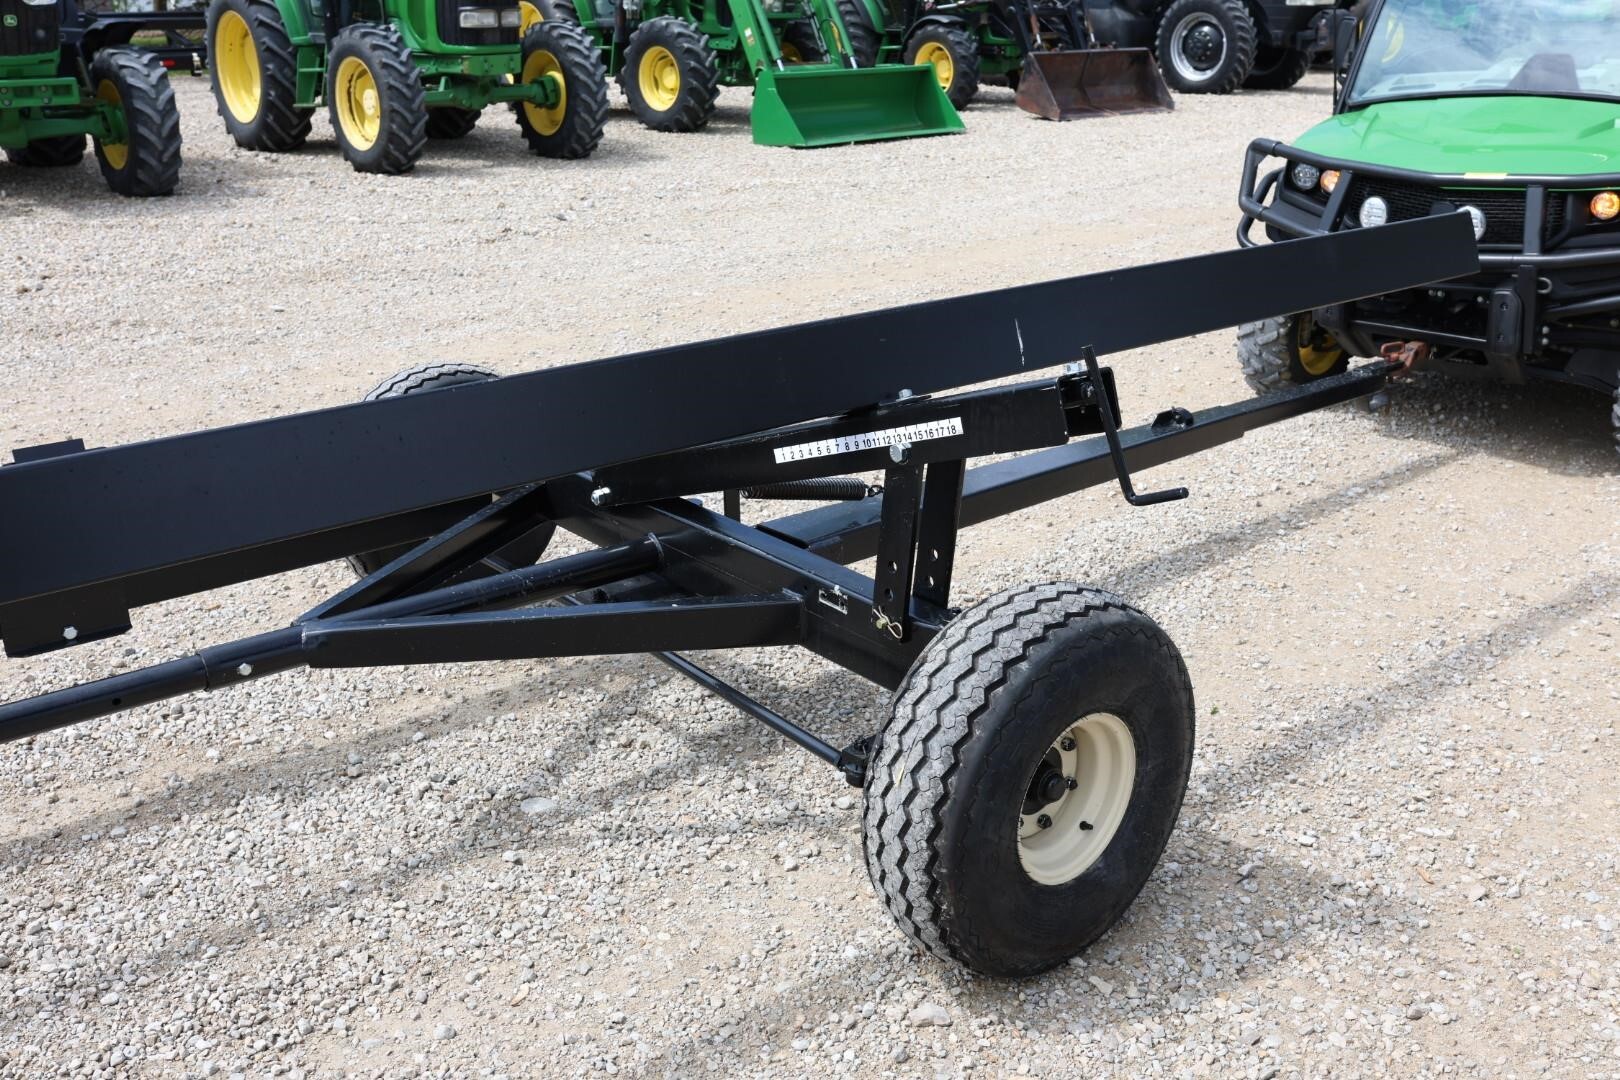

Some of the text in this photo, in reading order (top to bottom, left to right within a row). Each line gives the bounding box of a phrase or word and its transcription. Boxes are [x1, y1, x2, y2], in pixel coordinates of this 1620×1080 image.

[790, 451, 795, 459] 2
[799, 450, 804, 458] 3
[817, 447, 822, 455] 5
[826, 445, 831, 454] 6
[836, 444, 840, 452] 7
[844, 442, 850, 450] 8
[854, 441, 859, 449] 9
[863, 439, 871, 448] 10
[872, 438, 880, 446] 11
[883, 436, 892, 444] 12
[893, 434, 902, 443] 13
[903, 432, 912, 441] 14
[914, 430, 924, 440] 15
[924, 428, 934, 438] 16
[936, 427, 944, 436] 17
[946, 425, 956, 434] 18
